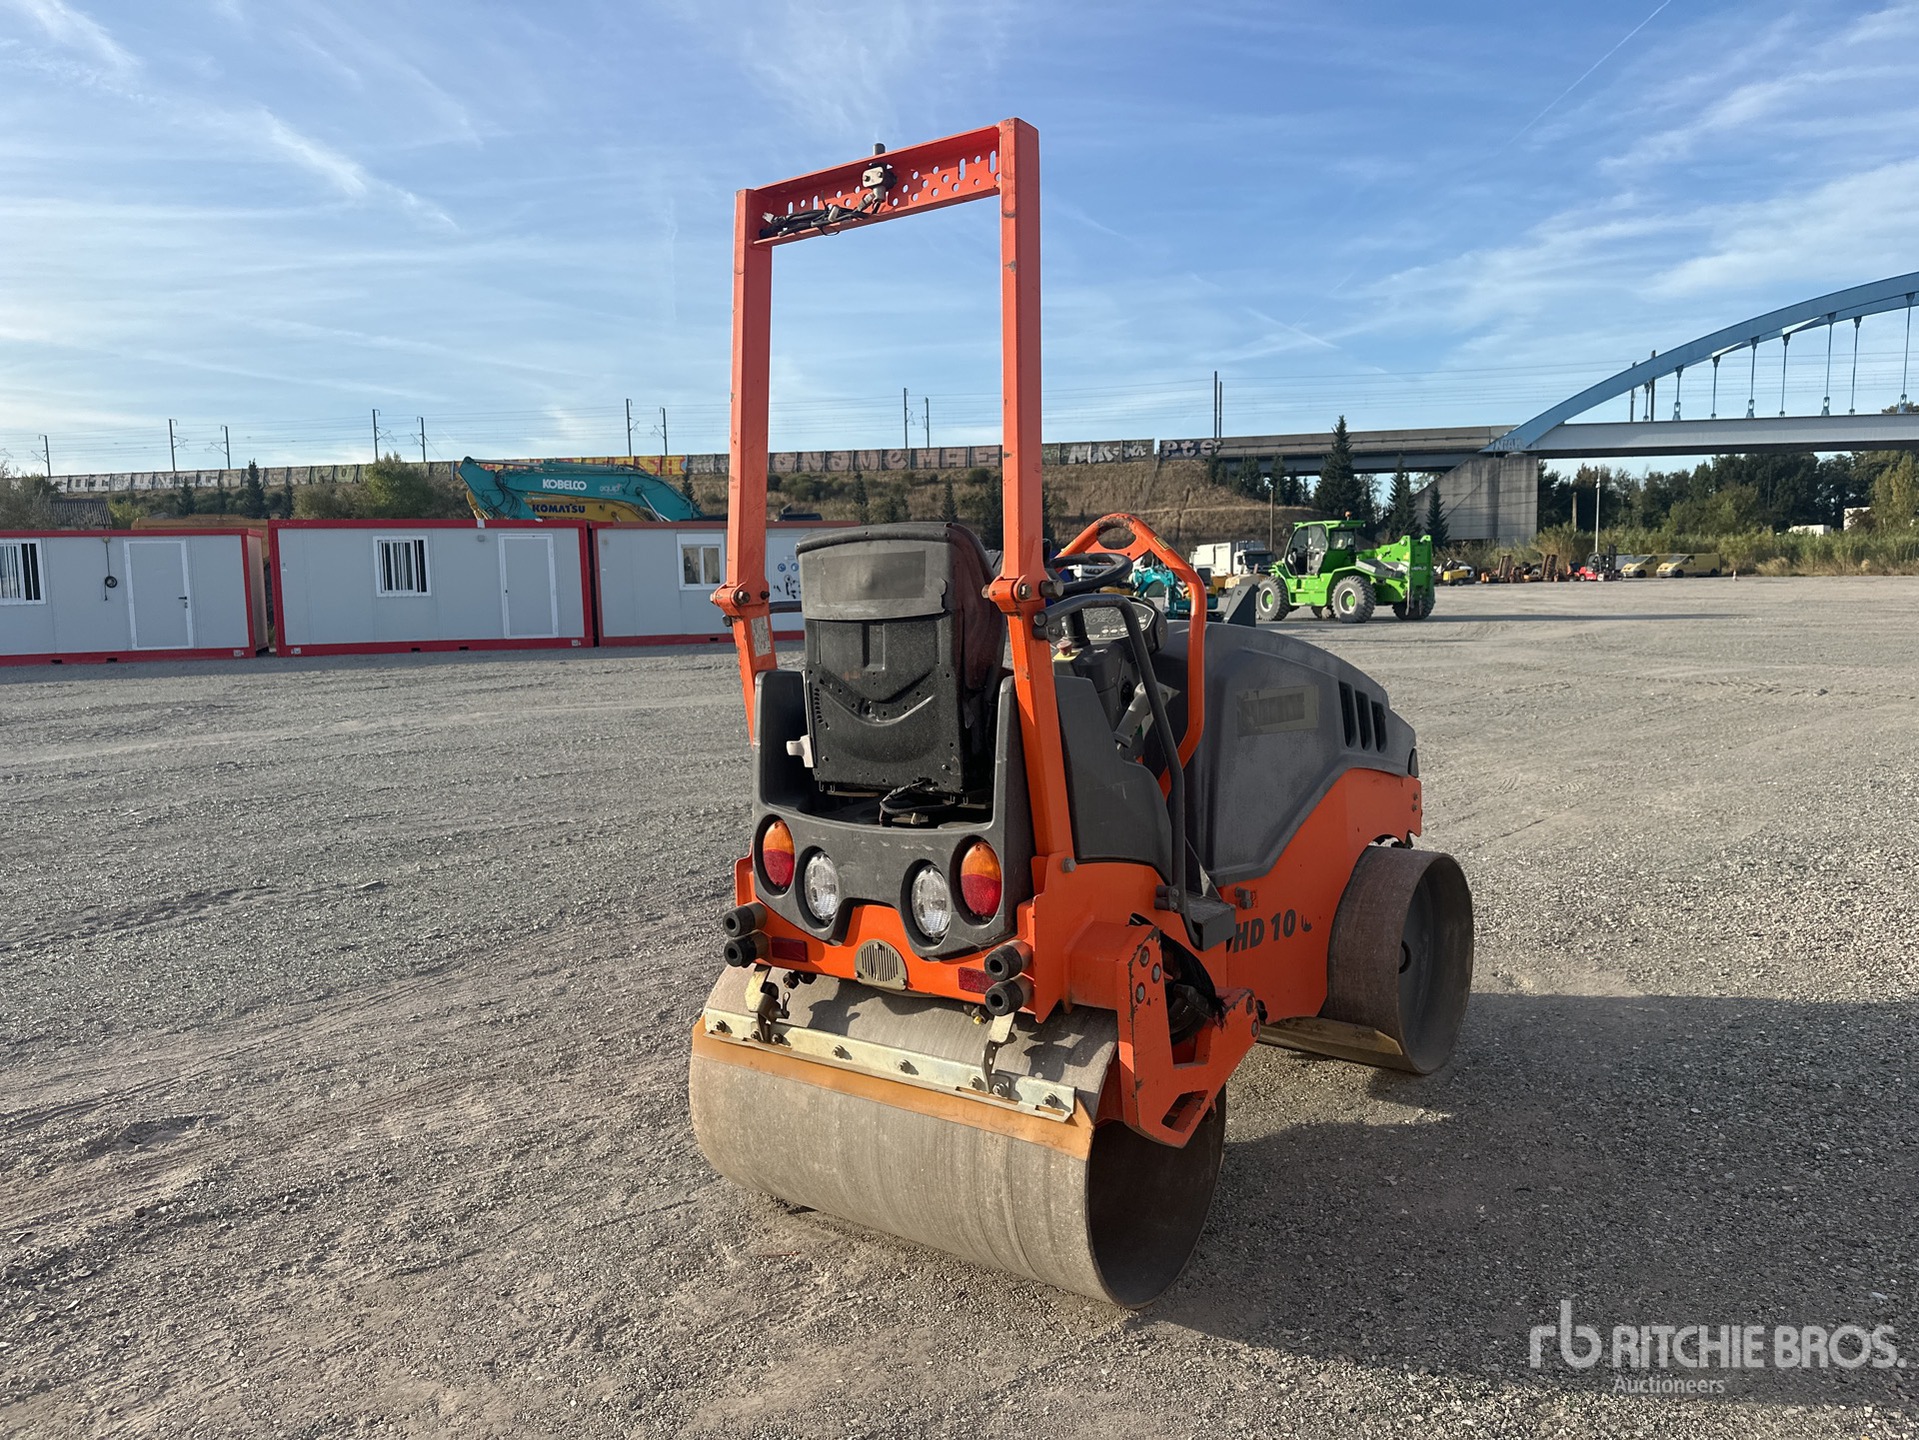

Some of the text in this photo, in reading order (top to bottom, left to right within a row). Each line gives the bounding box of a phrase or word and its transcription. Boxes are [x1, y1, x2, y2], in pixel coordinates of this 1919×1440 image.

[543, 479, 587, 491] KOBELCO
[532, 503, 586, 514] KOMATSU
[1233, 917, 1265, 954] HD
[1271, 908, 1297, 942] 10
